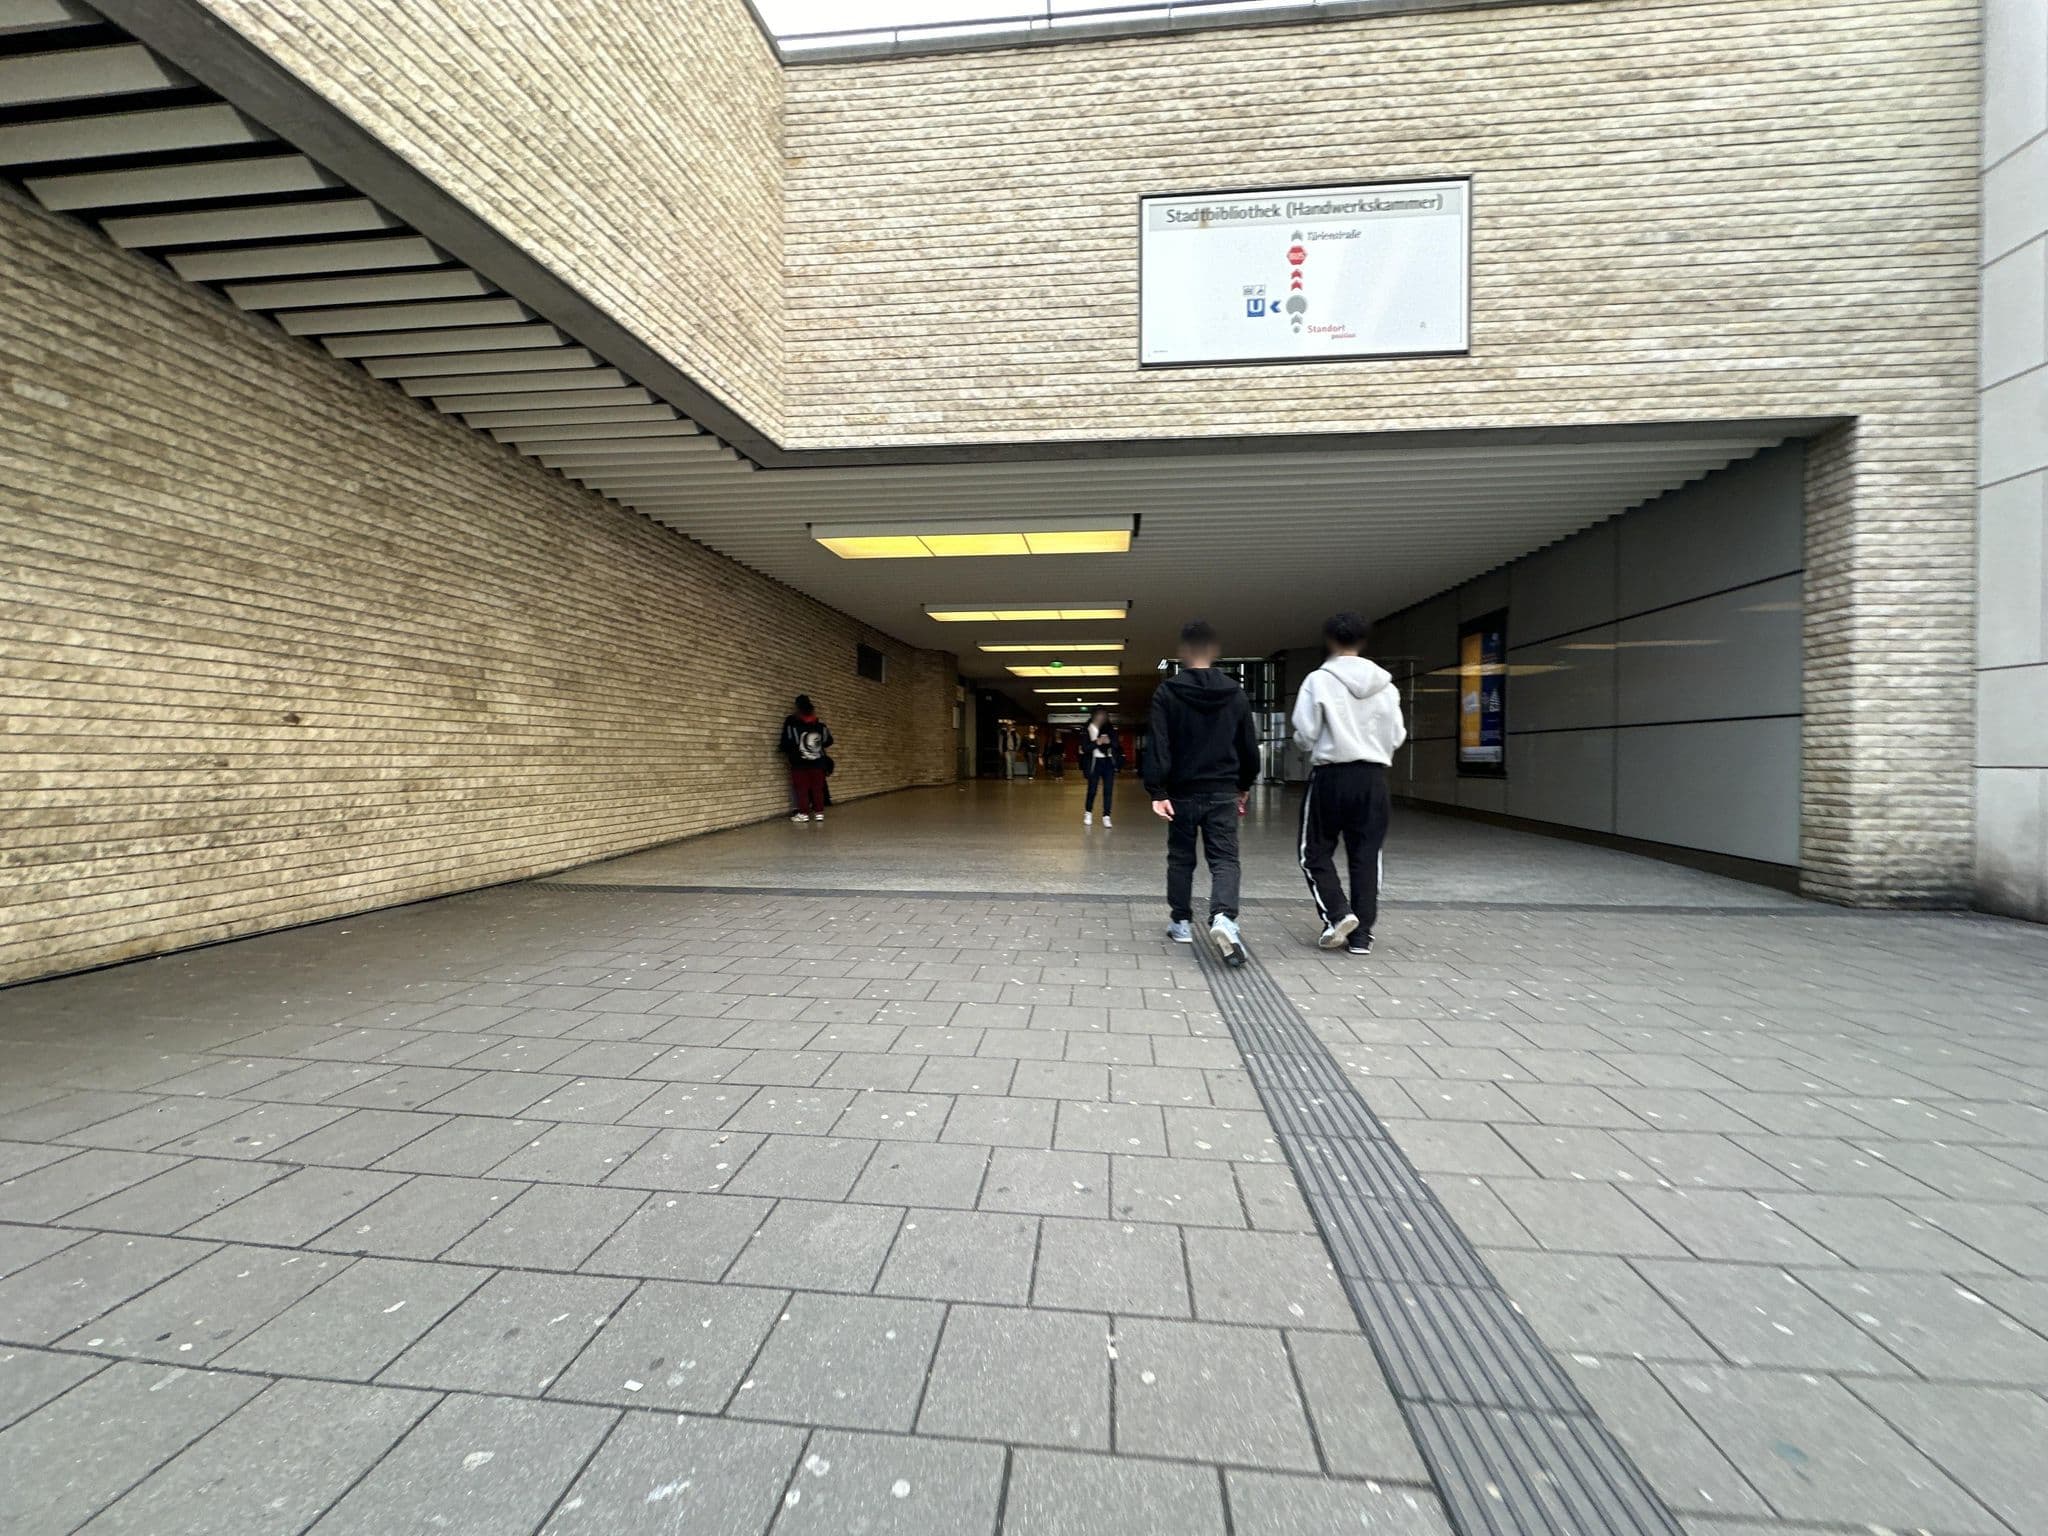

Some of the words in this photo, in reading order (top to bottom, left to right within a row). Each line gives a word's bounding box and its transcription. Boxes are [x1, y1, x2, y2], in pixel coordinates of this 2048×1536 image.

[1166, 203, 1281, 223] Stadtbibliothek
[1286, 193, 1444, 219] (Handwerkskammer)
[1249, 299, 1264, 314] U
[1307, 324, 1346, 334] Standort
